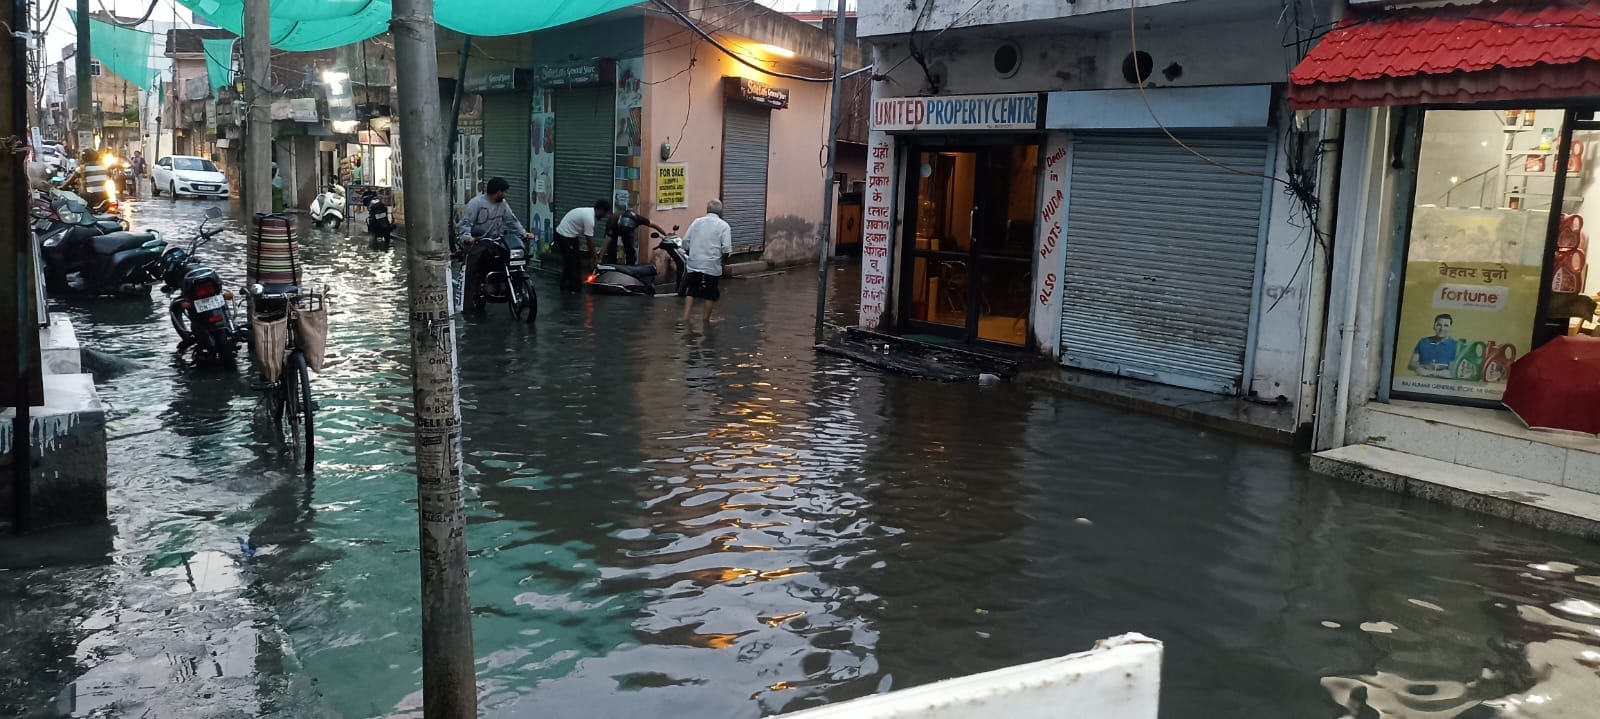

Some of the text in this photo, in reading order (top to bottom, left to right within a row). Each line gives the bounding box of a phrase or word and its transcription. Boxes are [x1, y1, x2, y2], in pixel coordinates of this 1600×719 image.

[875, 95, 1037, 126] UNITED PROPERTY CENTRE
[873, 161, 885, 174] हर
[1046, 147, 1067, 168] Deals
[660, 167, 684, 177] FOR SALE
[1050, 170, 1058, 182] in
[872, 188, 882, 202] के
[1042, 189, 1064, 223] HUDA
[1040, 221, 1063, 260] PLOTS
[1439, 262, 1509, 283] बेहतर चुनो
[1039, 272, 1057, 306] ALSO
[1441, 287, 1498, 304] fortune
